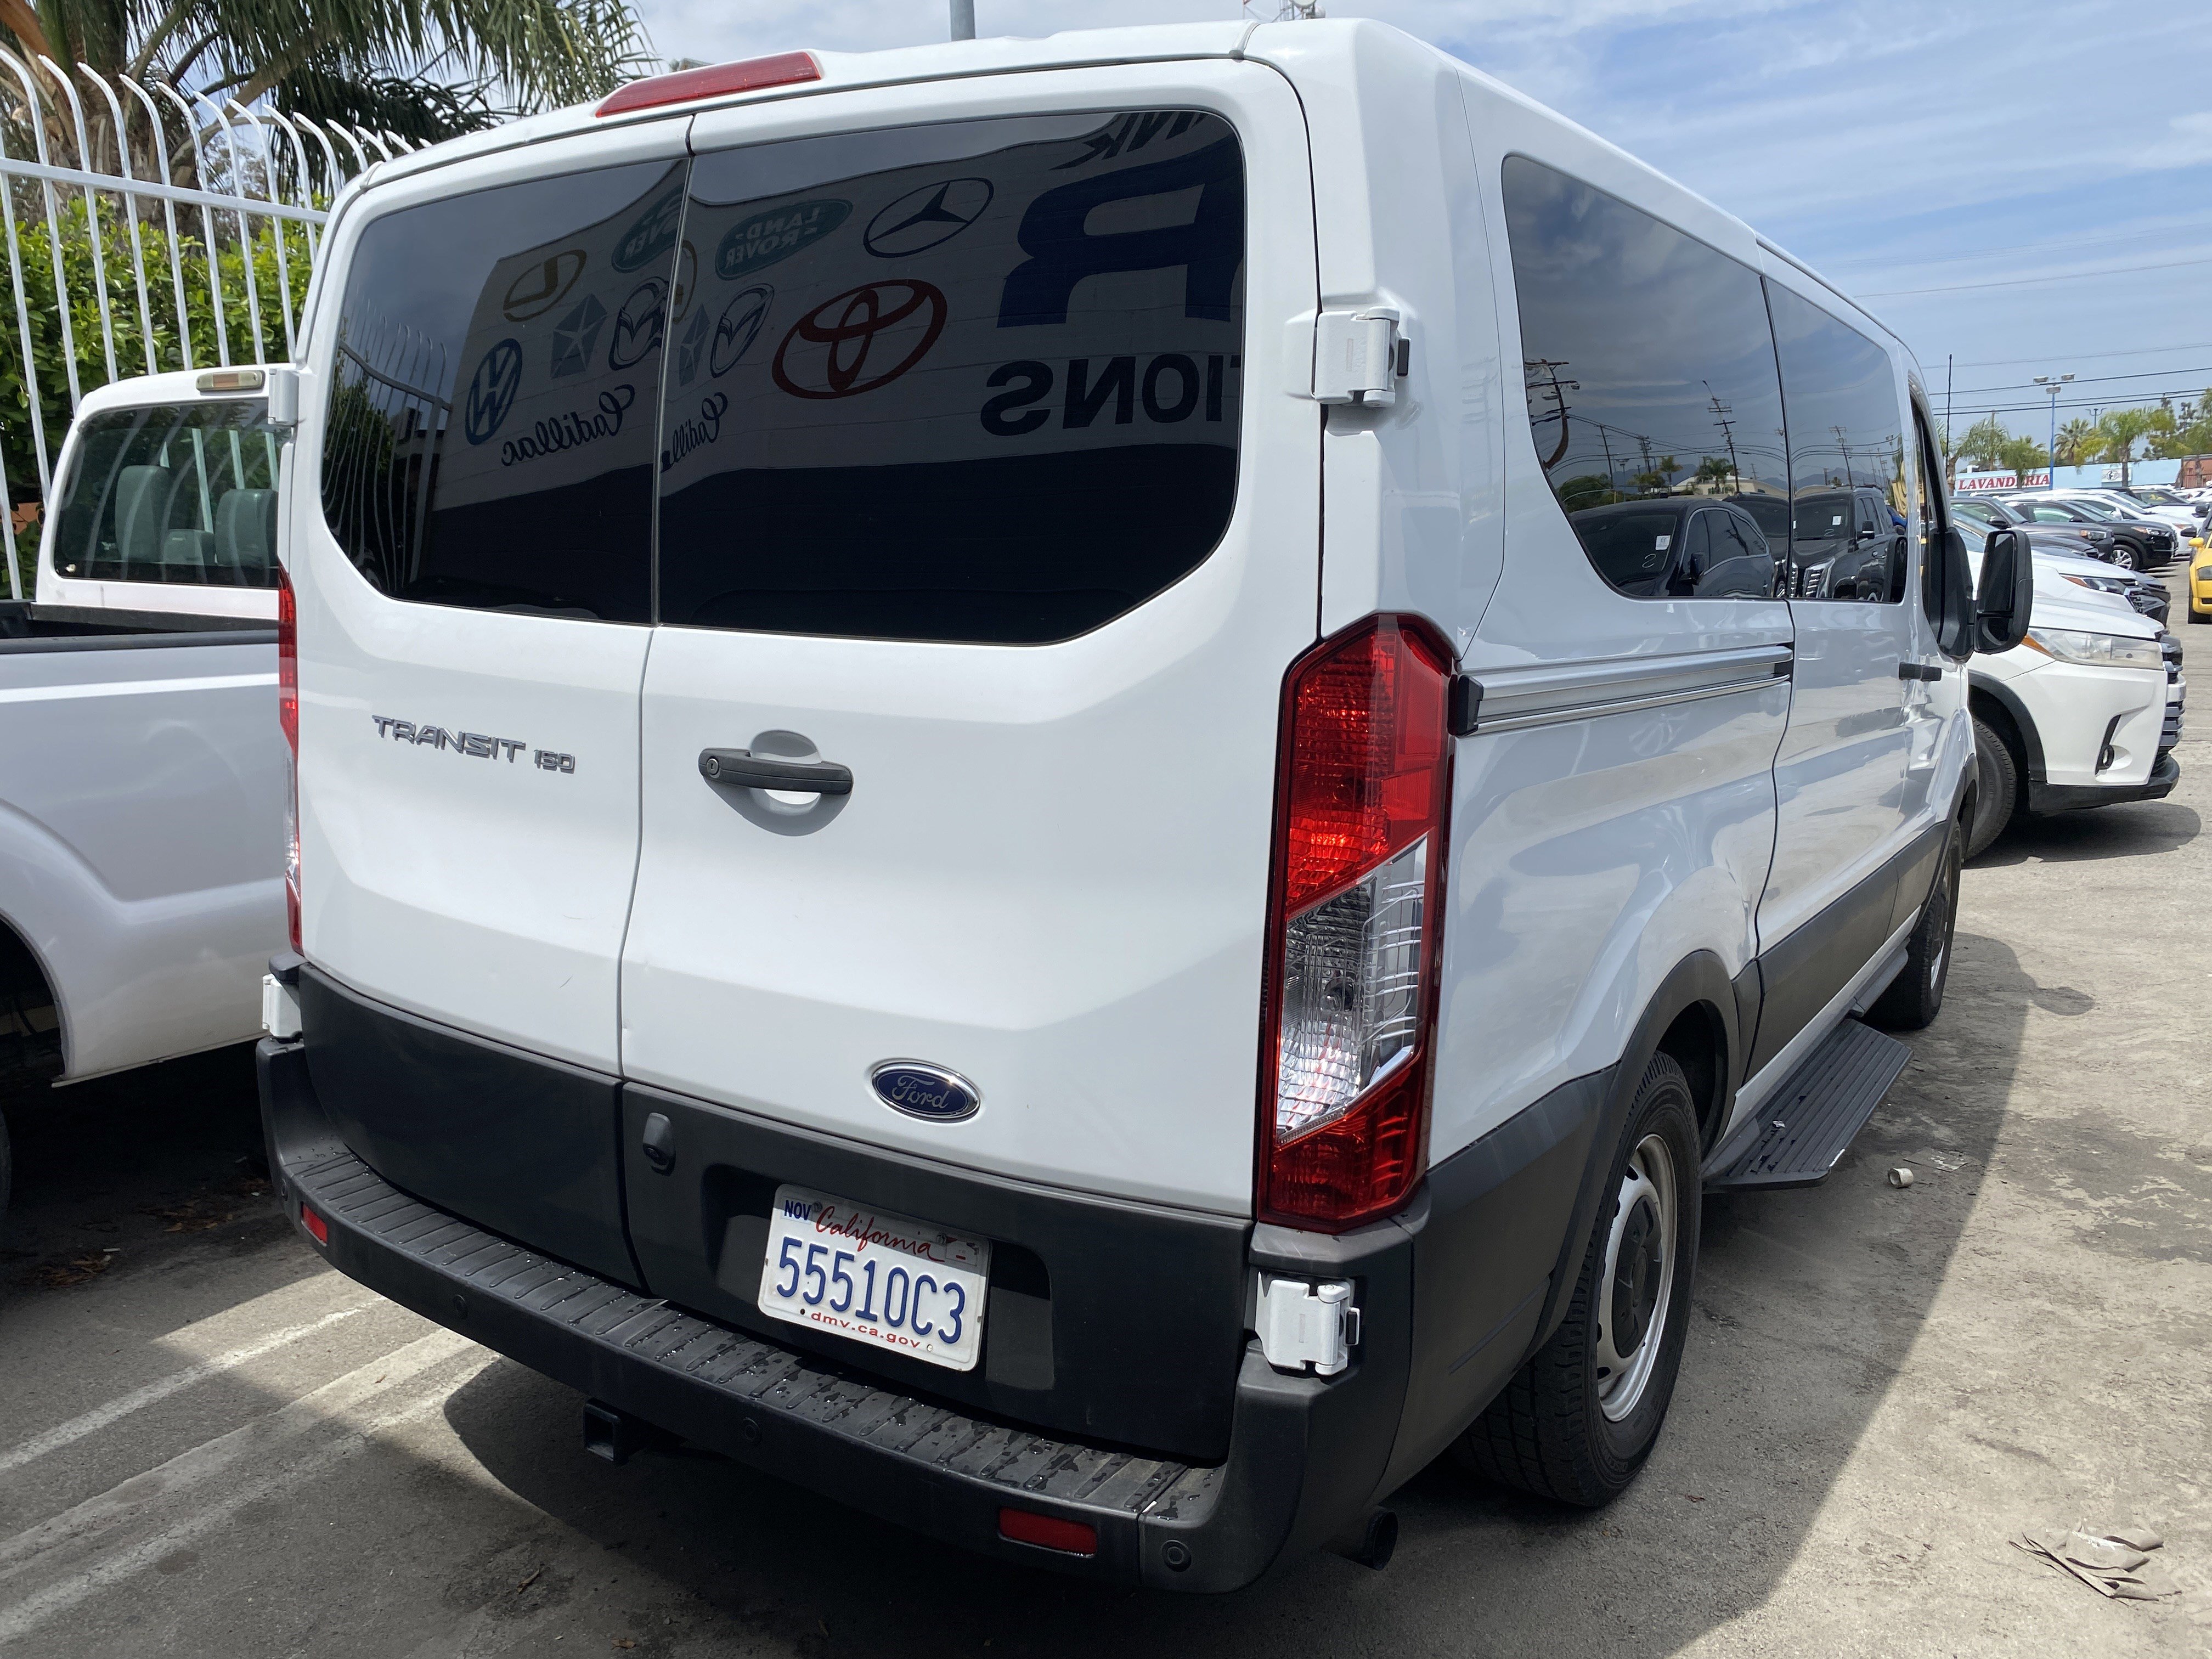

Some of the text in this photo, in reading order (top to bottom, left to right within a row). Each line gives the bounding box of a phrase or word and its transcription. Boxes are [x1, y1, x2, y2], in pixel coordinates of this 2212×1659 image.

[1958, 474, 2050, 490] LAVANDRIA
[371, 714, 575, 774] TRANSIT 150
[891, 1075, 950, 1109] Ford
[784, 1199, 812, 1221] NOV
[815, 1205, 945, 1262] California
[776, 1236, 966, 1344] 55510C3
[810, 1310, 921, 1348] dmv.ca.gov
